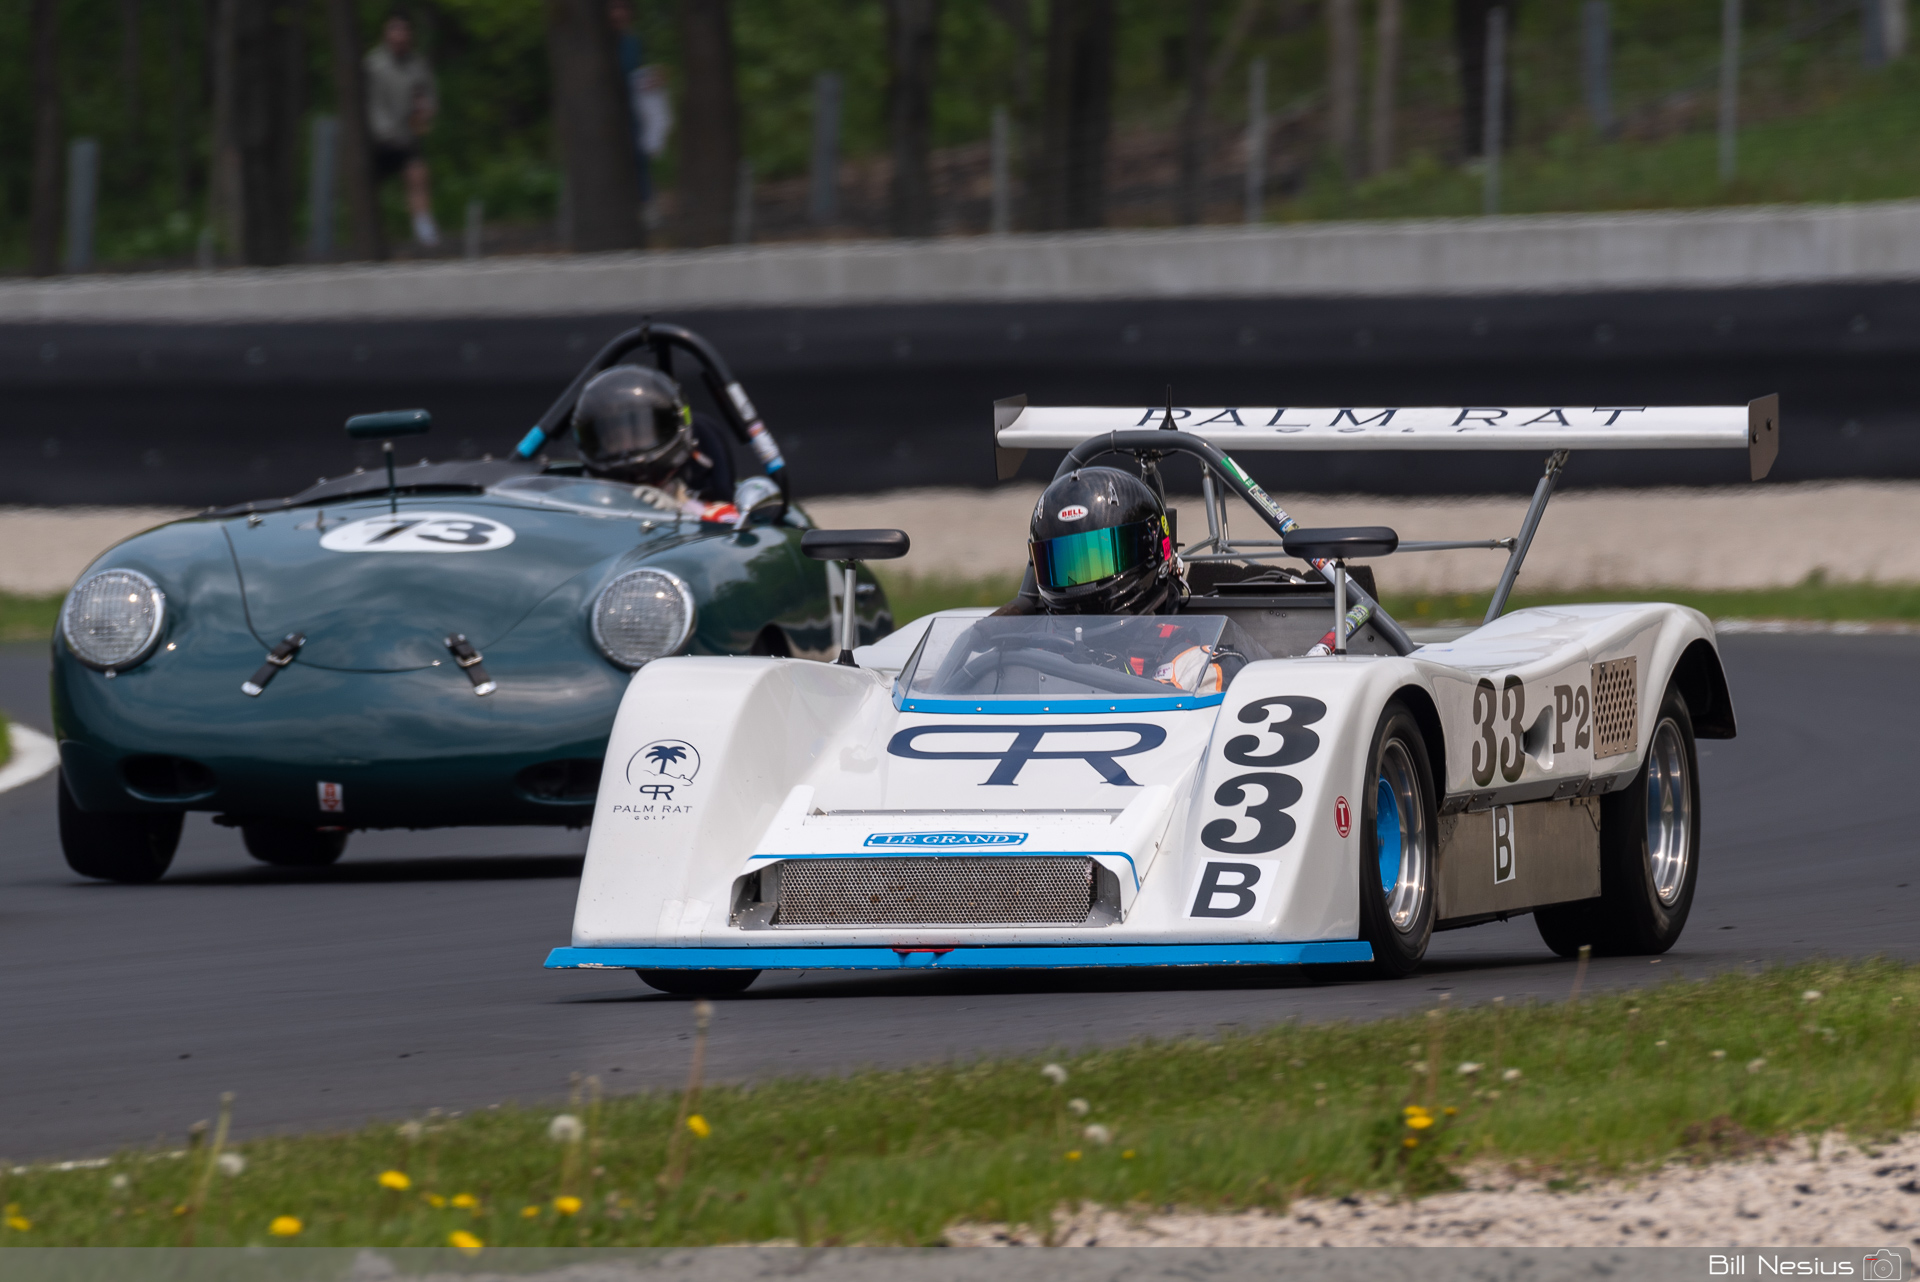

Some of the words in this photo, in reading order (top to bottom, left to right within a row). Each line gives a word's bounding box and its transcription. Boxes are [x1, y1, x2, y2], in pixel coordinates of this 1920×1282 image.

[1136, 407, 1398, 427] PALM
[1449, 405, 1647, 427] RAT
[1061, 508, 1083, 518] BELL
[363, 518, 498, 546] 73
[1471, 674, 1527, 788] 33
[1552, 684, 1591, 755] P2
[612, 804, 655, 814] PALM
[661, 804, 693, 814] RAT
[884, 835, 916, 844] LE
[922, 835, 1010, 844] GRAND
[1495, 805, 1514, 882] B
[1190, 862, 1261, 919] B
